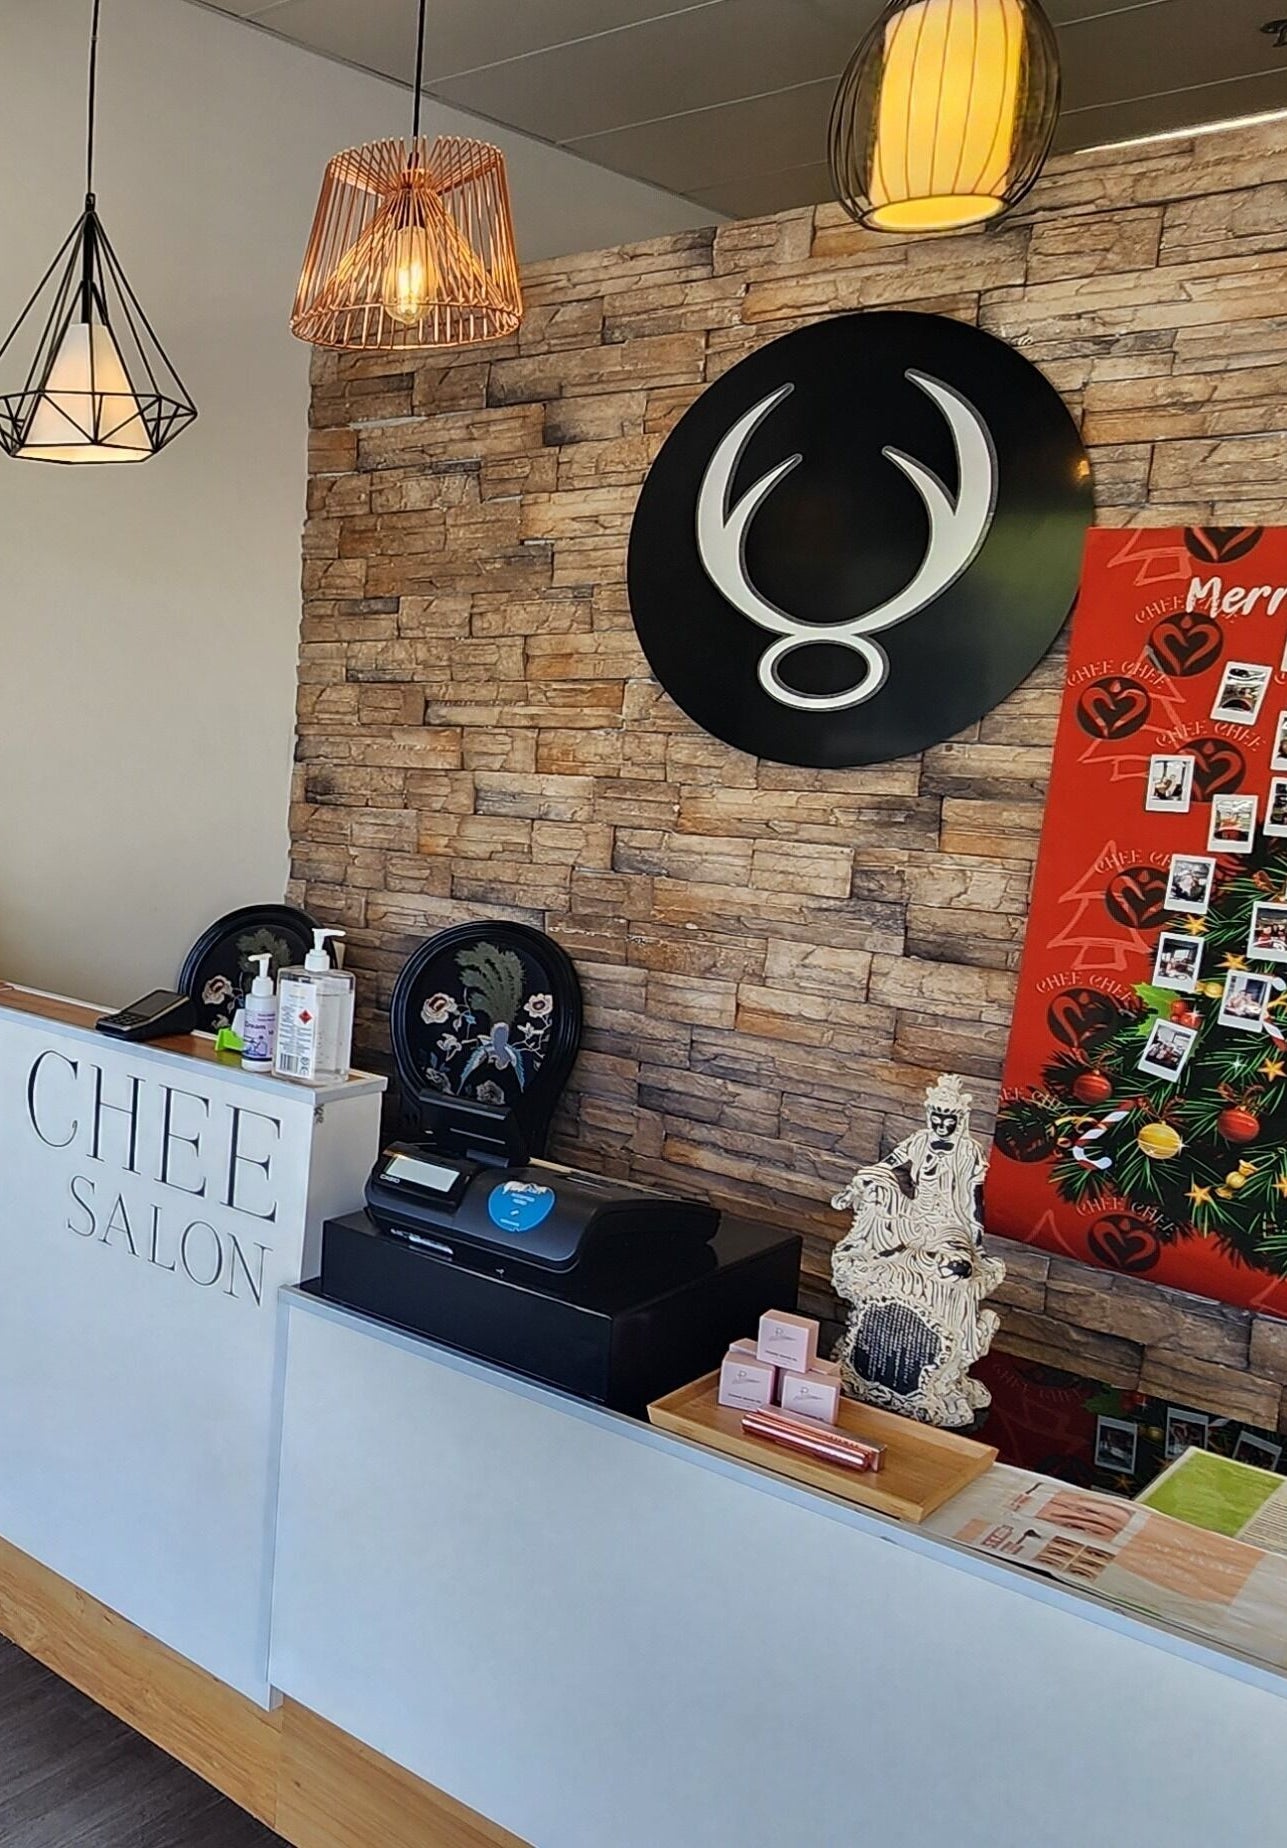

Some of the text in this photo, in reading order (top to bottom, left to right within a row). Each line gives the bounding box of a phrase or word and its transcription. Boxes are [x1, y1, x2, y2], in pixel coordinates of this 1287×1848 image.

[1067, 660, 1114, 686] CHEE
[1214, 722, 1267, 752] CHEE
[1035, 971, 1083, 993] CHEE
[27, 1050, 282, 1224] CHEE
[67, 1174, 273, 1307] SALON
